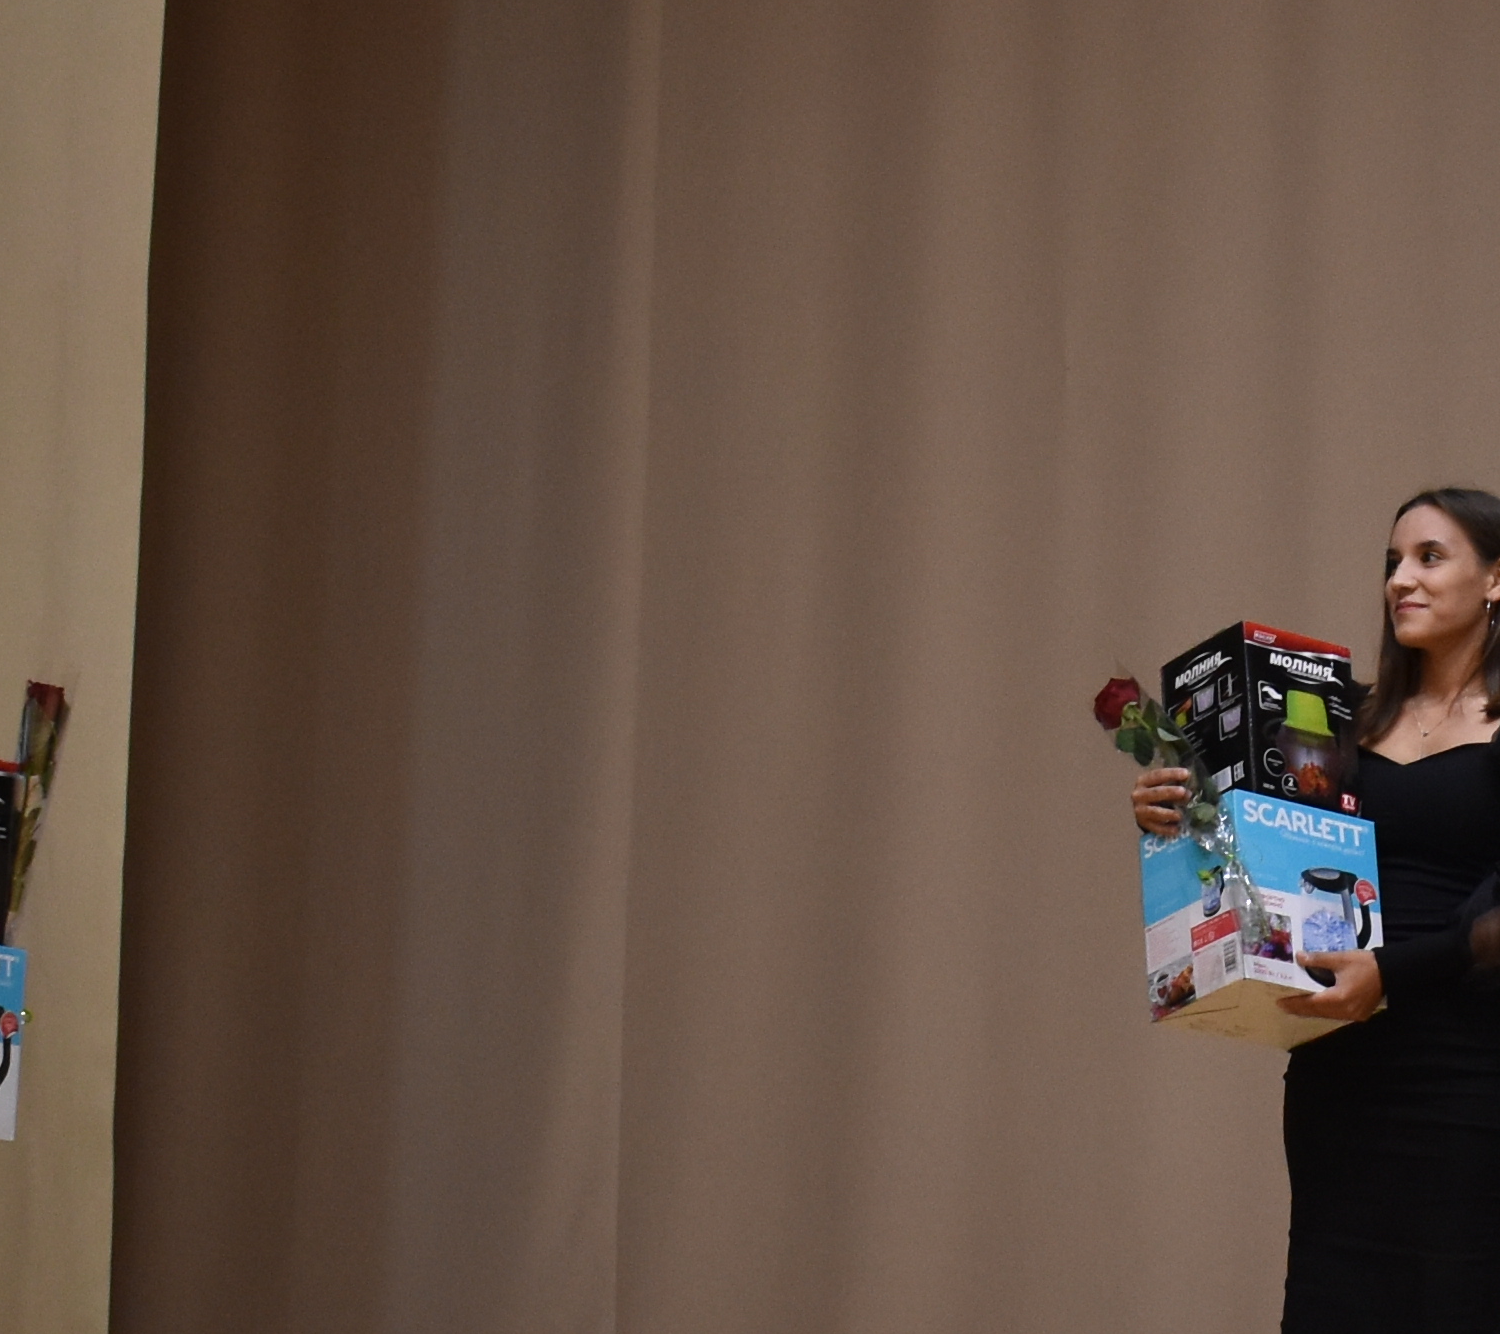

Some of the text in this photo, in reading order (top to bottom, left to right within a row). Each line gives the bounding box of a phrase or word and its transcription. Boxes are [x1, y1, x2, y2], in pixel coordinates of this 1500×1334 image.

[1174, 650, 1223, 690] МОЛНИЯ
[1269, 652, 1336, 682] МОЛНИЯ
[1287, 776, 1296, 787] 2
[1341, 793, 1357, 805] TV
[1243, 798, 1364, 849] SCARLETT
